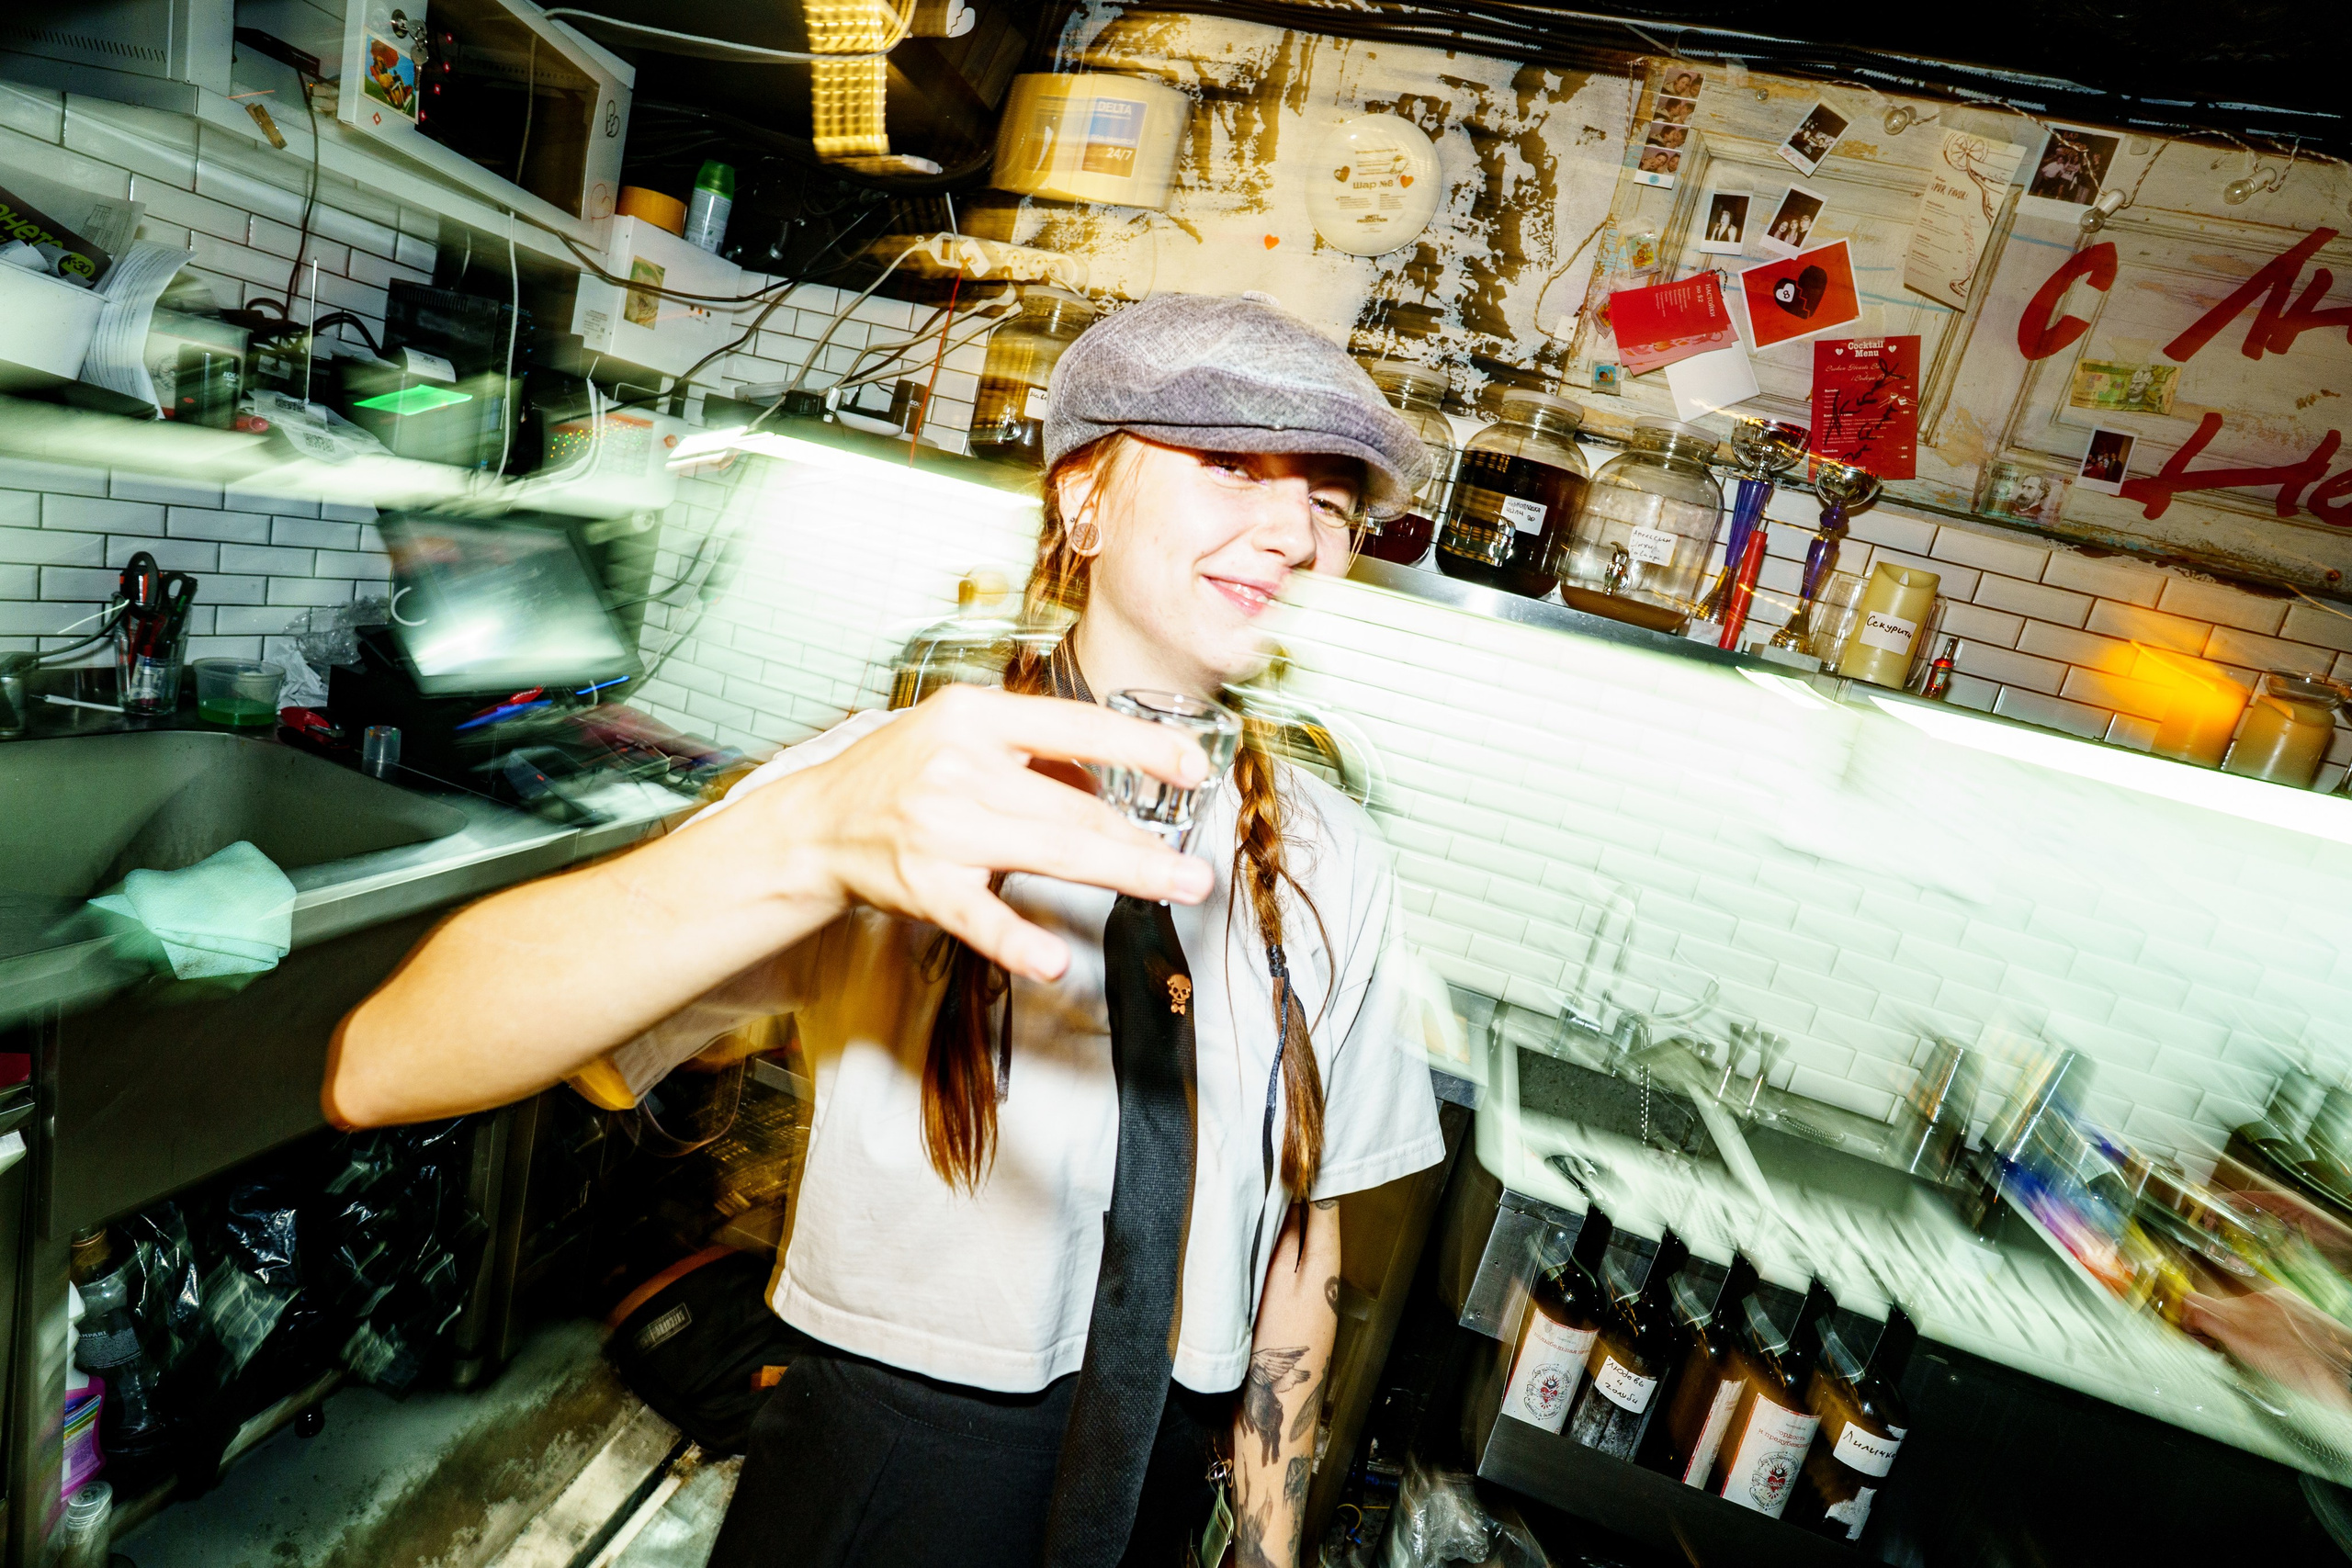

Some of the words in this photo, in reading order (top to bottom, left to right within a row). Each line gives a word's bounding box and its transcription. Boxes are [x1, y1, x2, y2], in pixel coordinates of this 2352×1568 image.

[1098, 101, 1132, 116] DELTA
[1106, 147, 1133, 161] 24/7
[1705, 283, 1716, 318] НАСТОЙКИ
[1782, 289, 1791, 299] 8
[1848, 340, 1884, 351] Cocktail
[1854, 349, 1880, 358] Menu
[1866, 615, 1913, 640] Секурити
[80, 1330, 107, 1338] MPARI
[1604, 1382, 1639, 1405] голуби
